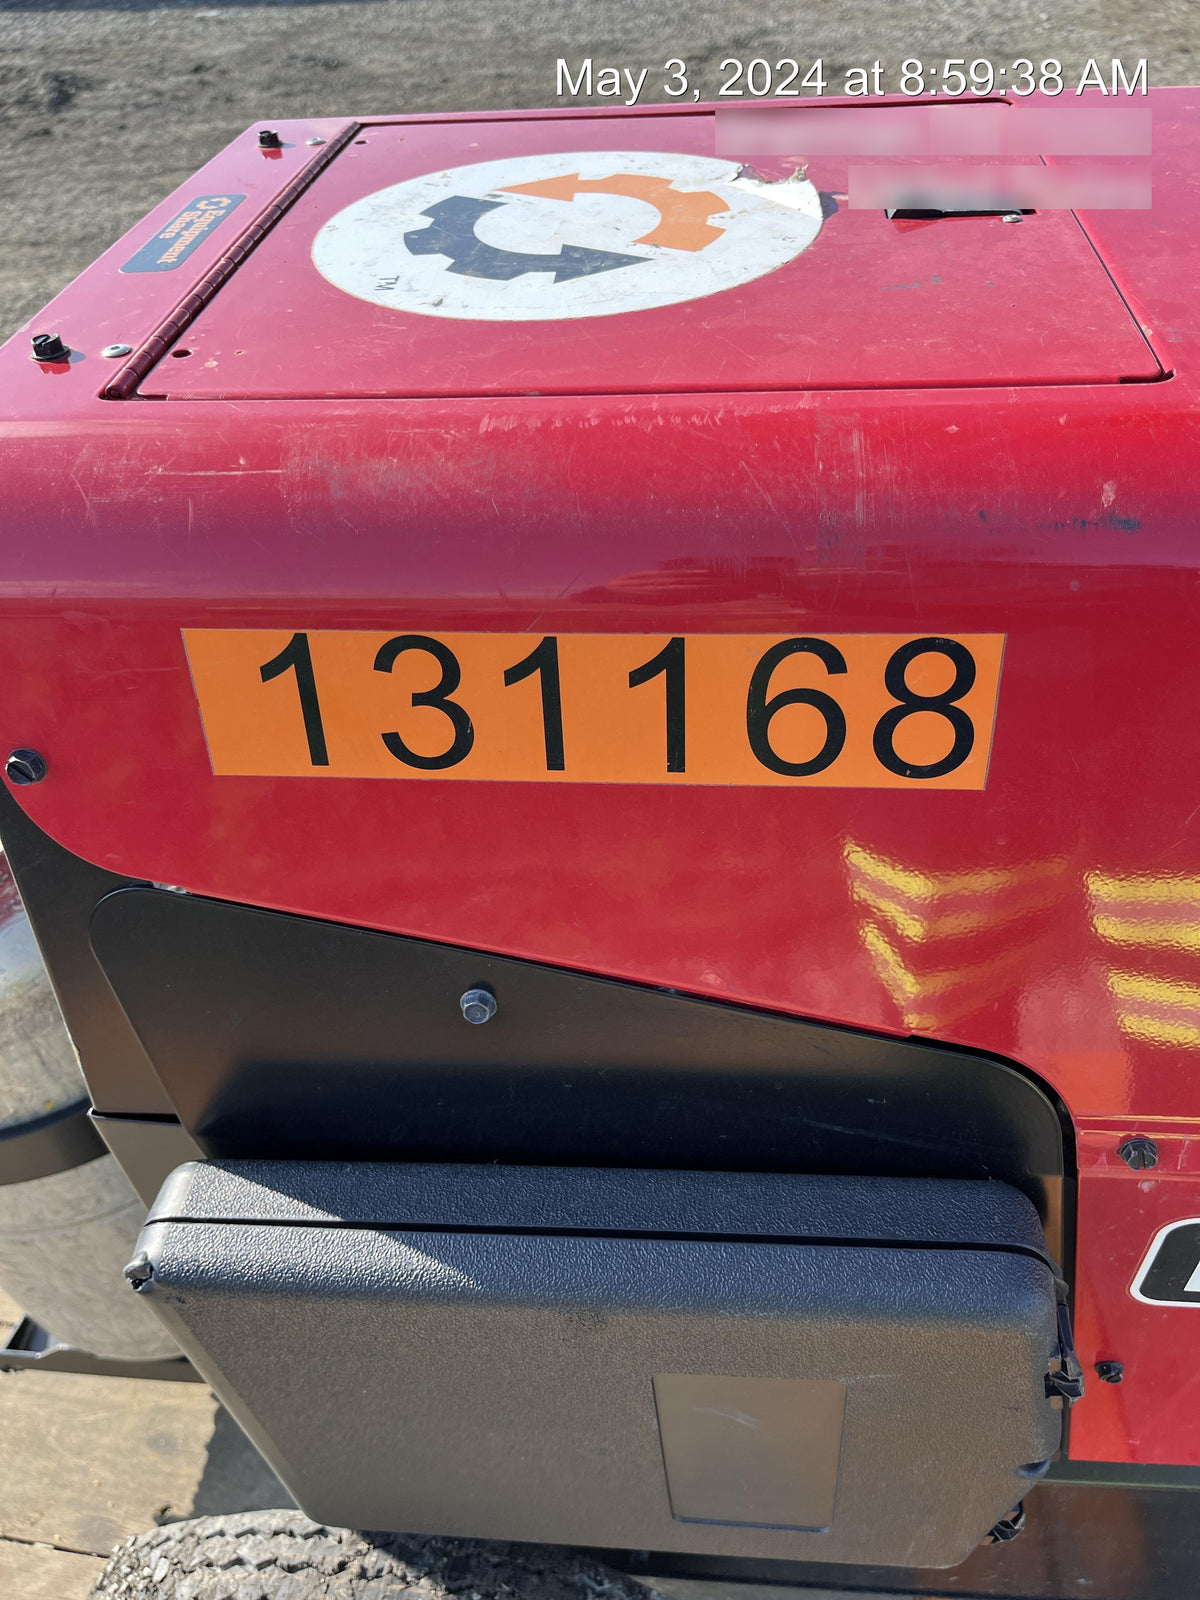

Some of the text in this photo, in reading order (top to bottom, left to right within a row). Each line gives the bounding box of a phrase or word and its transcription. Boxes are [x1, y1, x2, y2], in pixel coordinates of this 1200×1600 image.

[156, 209, 226, 264] Equipment
[159, 211, 202, 239] Share
[259, 632, 977, 778] 131168
